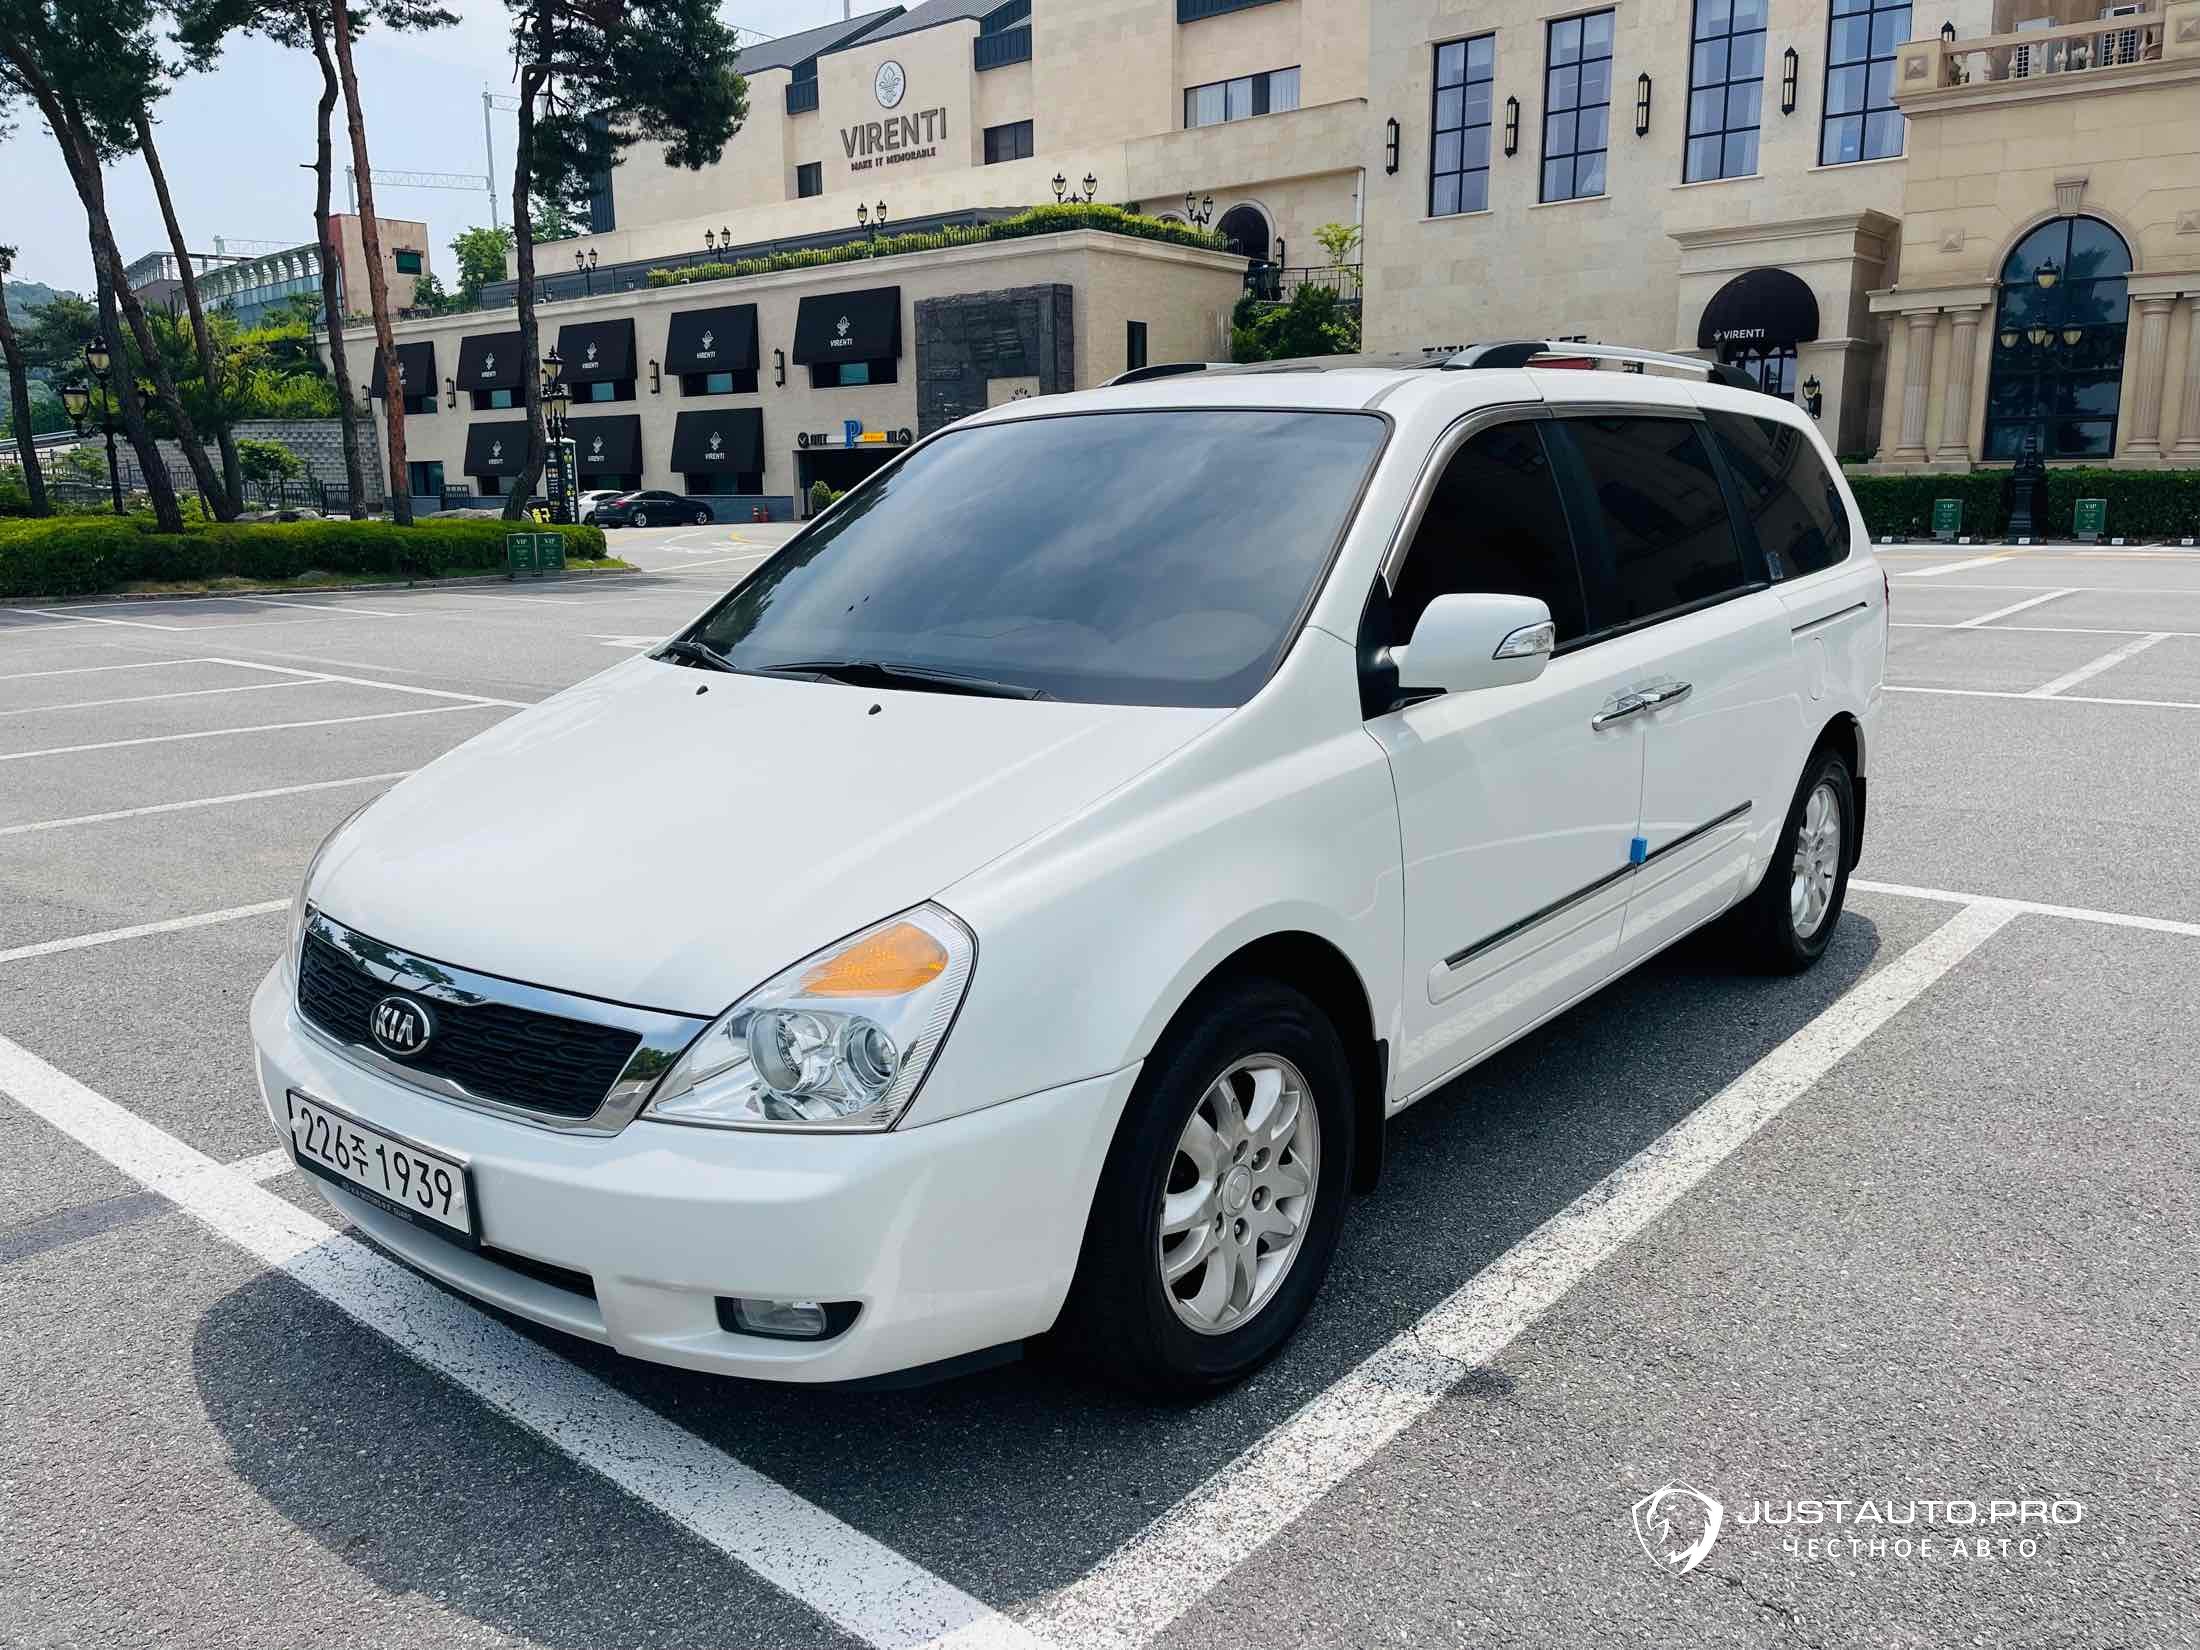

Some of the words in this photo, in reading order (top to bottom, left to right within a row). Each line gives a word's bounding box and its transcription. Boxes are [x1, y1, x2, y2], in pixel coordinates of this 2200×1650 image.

[840, 107, 947, 158] VIRENTI
[851, 158, 873, 171] MAKE
[875, 156, 884, 167] IT
[886, 147, 936, 164] MEMORABLE
[1723, 329, 1765, 339] VIRENTI
[843, 420, 863, 448] P
[376, 1005, 414, 1046] KIA
[301, 1107, 369, 1176] 226주
[376, 1144, 453, 1215] 1939
